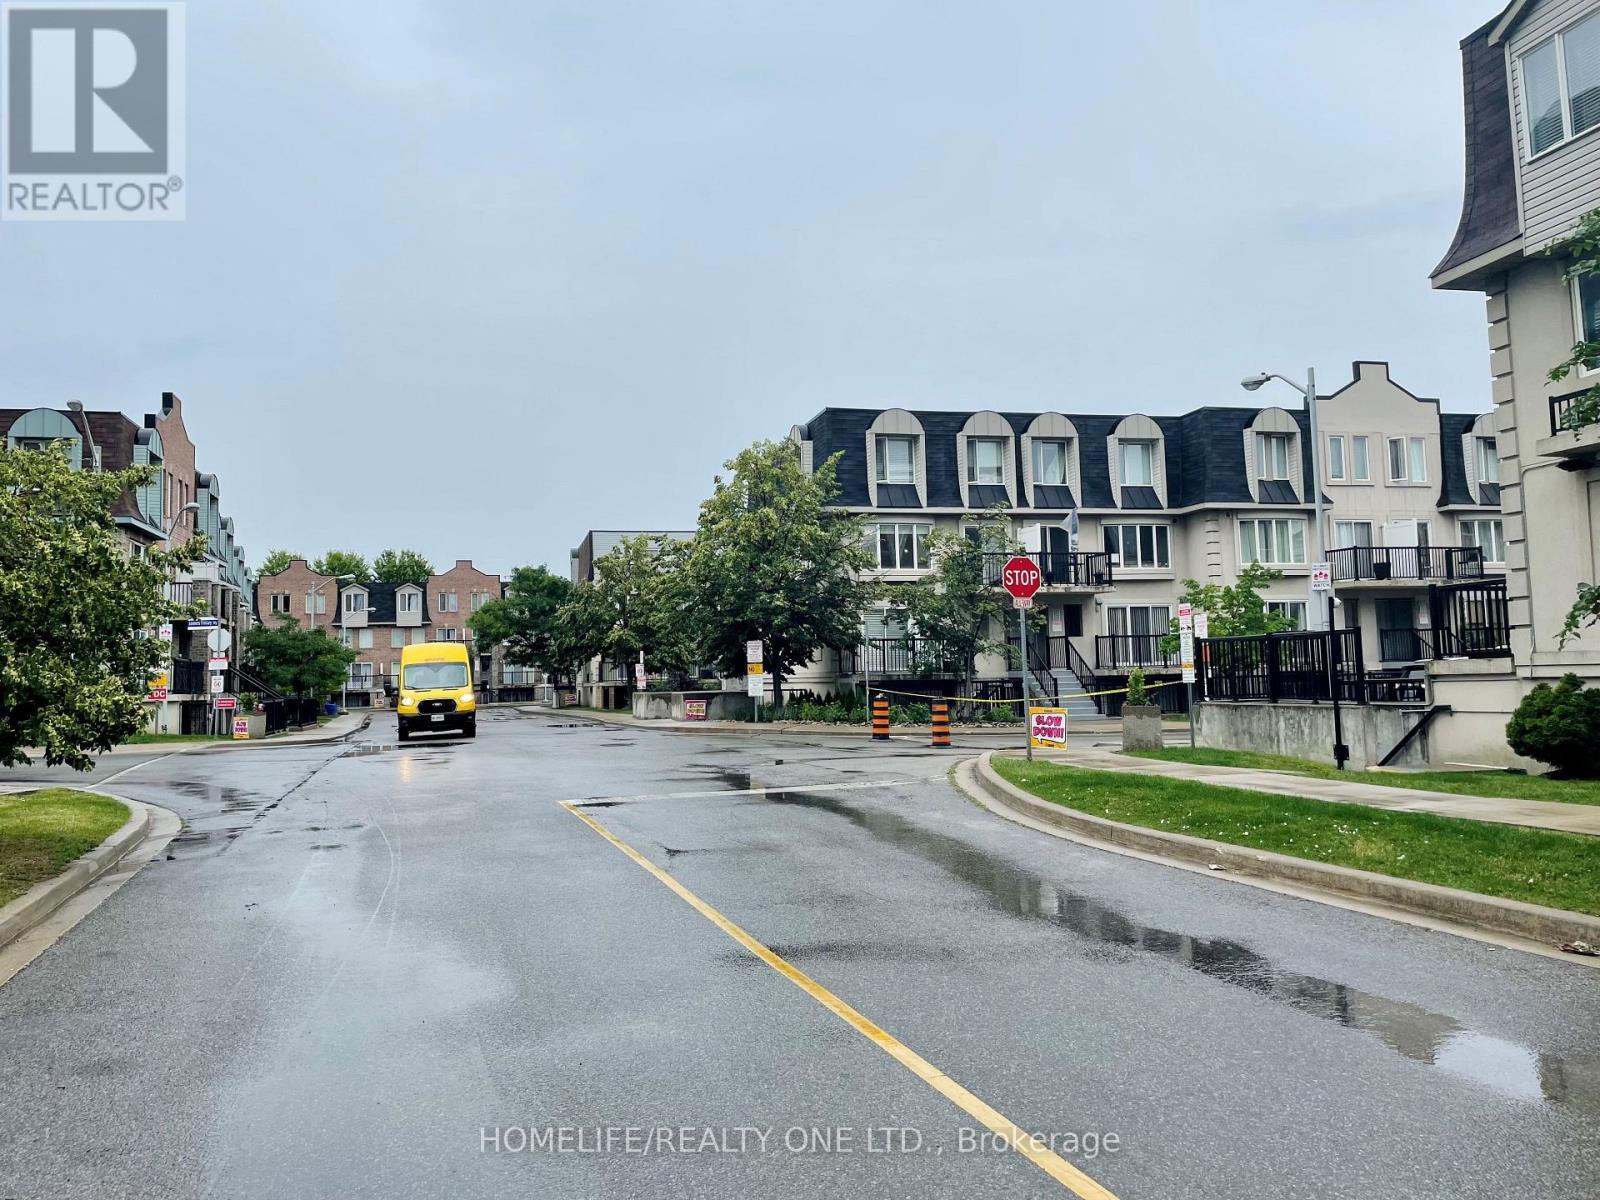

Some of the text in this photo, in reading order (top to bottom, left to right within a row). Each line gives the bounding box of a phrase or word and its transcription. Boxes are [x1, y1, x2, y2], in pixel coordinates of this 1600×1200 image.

[1005, 570, 1038, 586] STOP
[1035, 715, 1062, 726] SLOW
[1033, 726, 1064, 738] DOWN!
